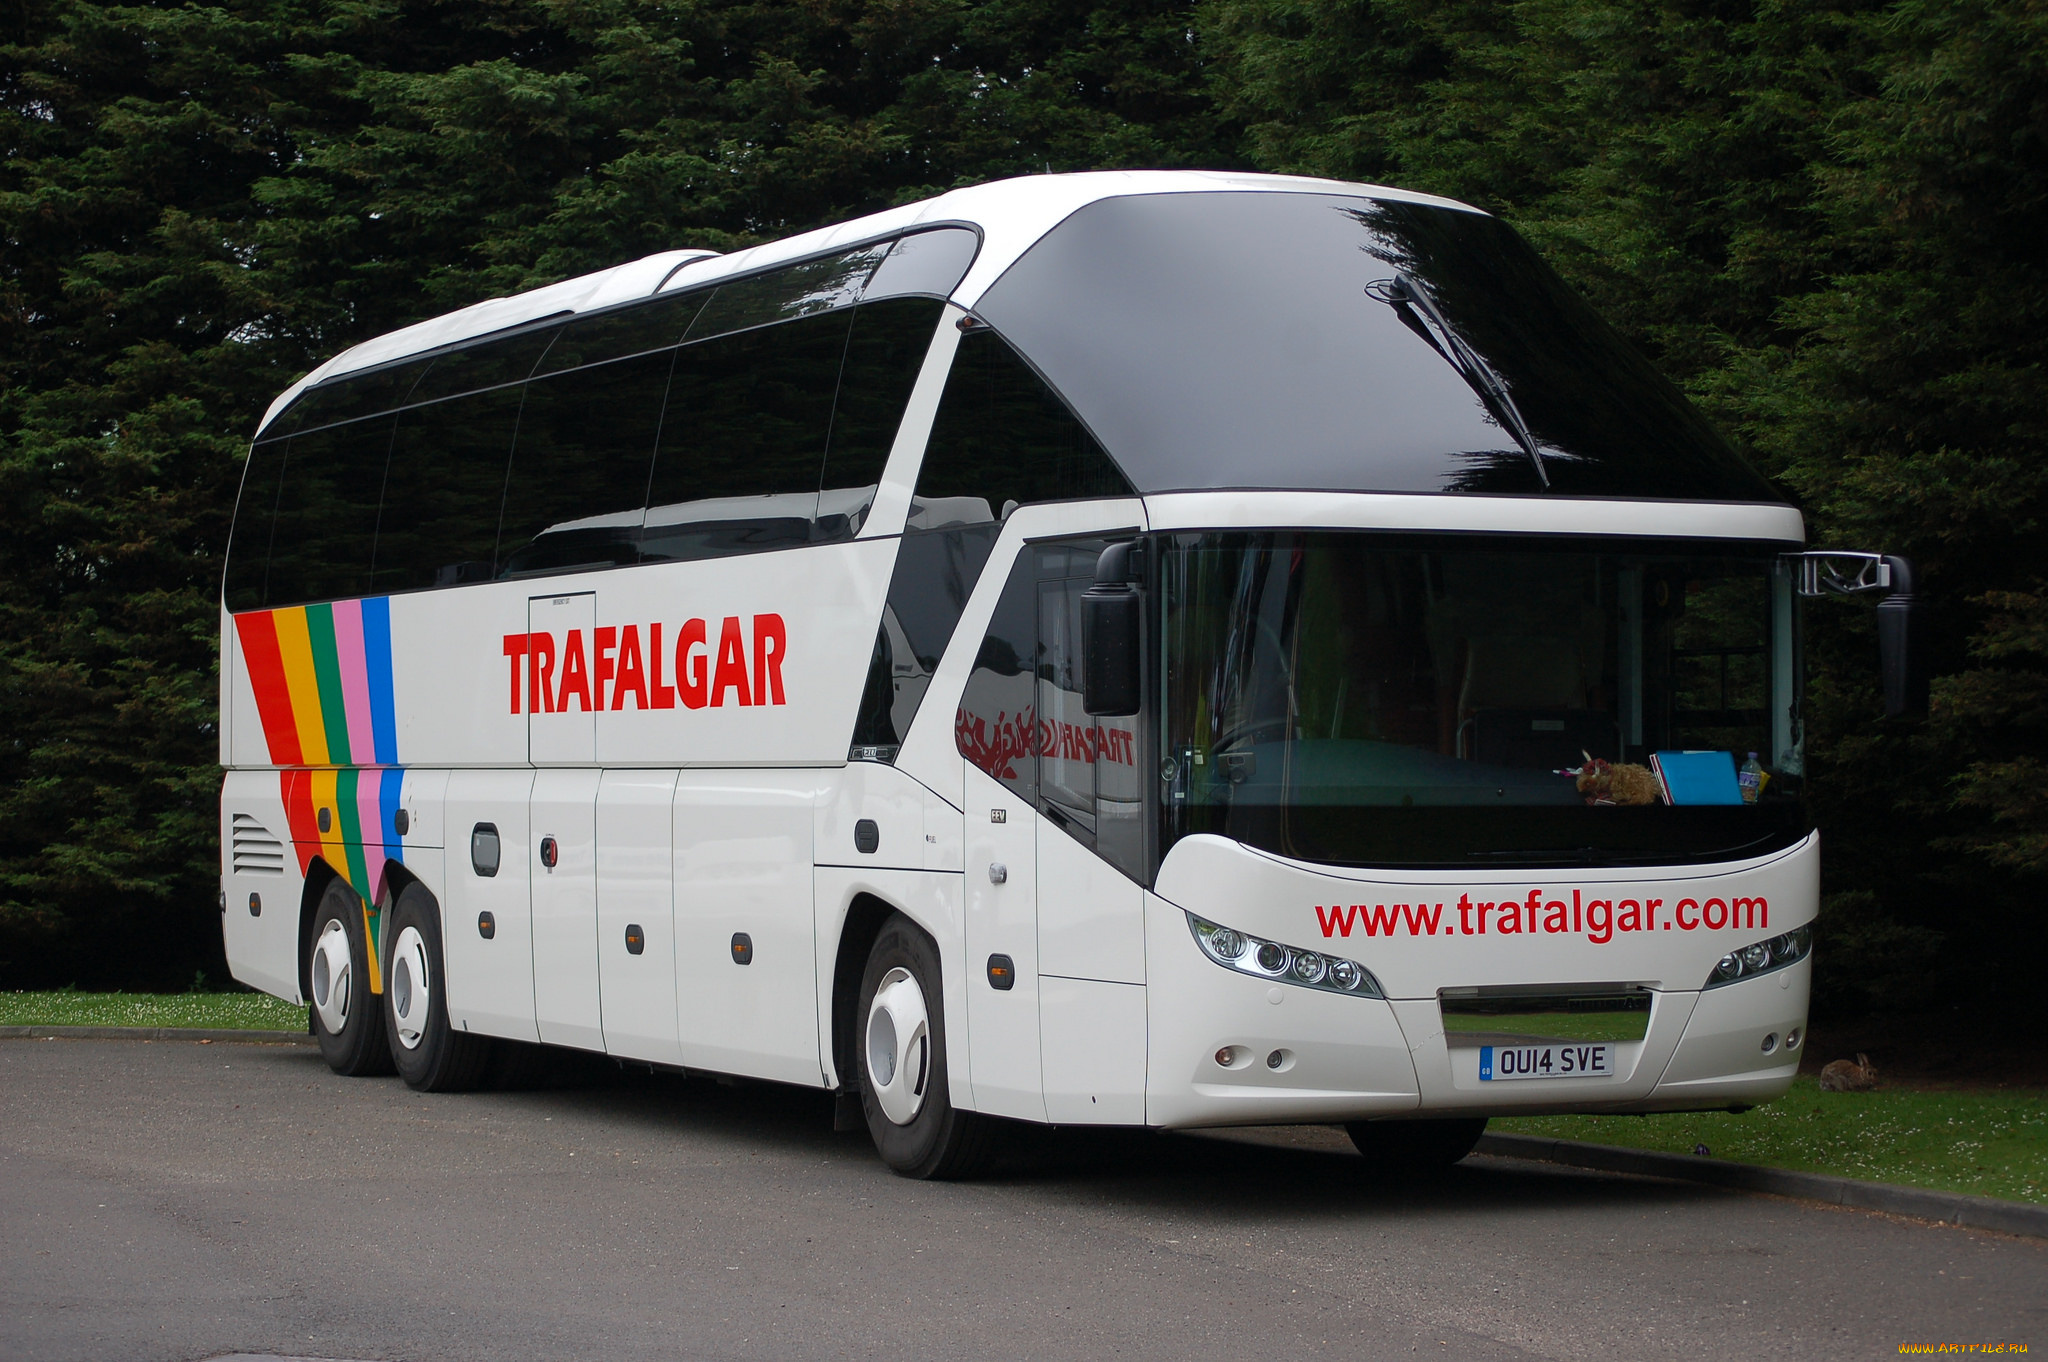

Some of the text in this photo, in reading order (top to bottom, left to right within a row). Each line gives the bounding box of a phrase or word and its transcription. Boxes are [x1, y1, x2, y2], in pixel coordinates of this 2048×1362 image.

[504, 614, 786, 714] TRAFALGAR
[1316, 890, 1767, 943] www.trafalgar.com
[1501, 1046, 1606, 1074] OU14 SVE
